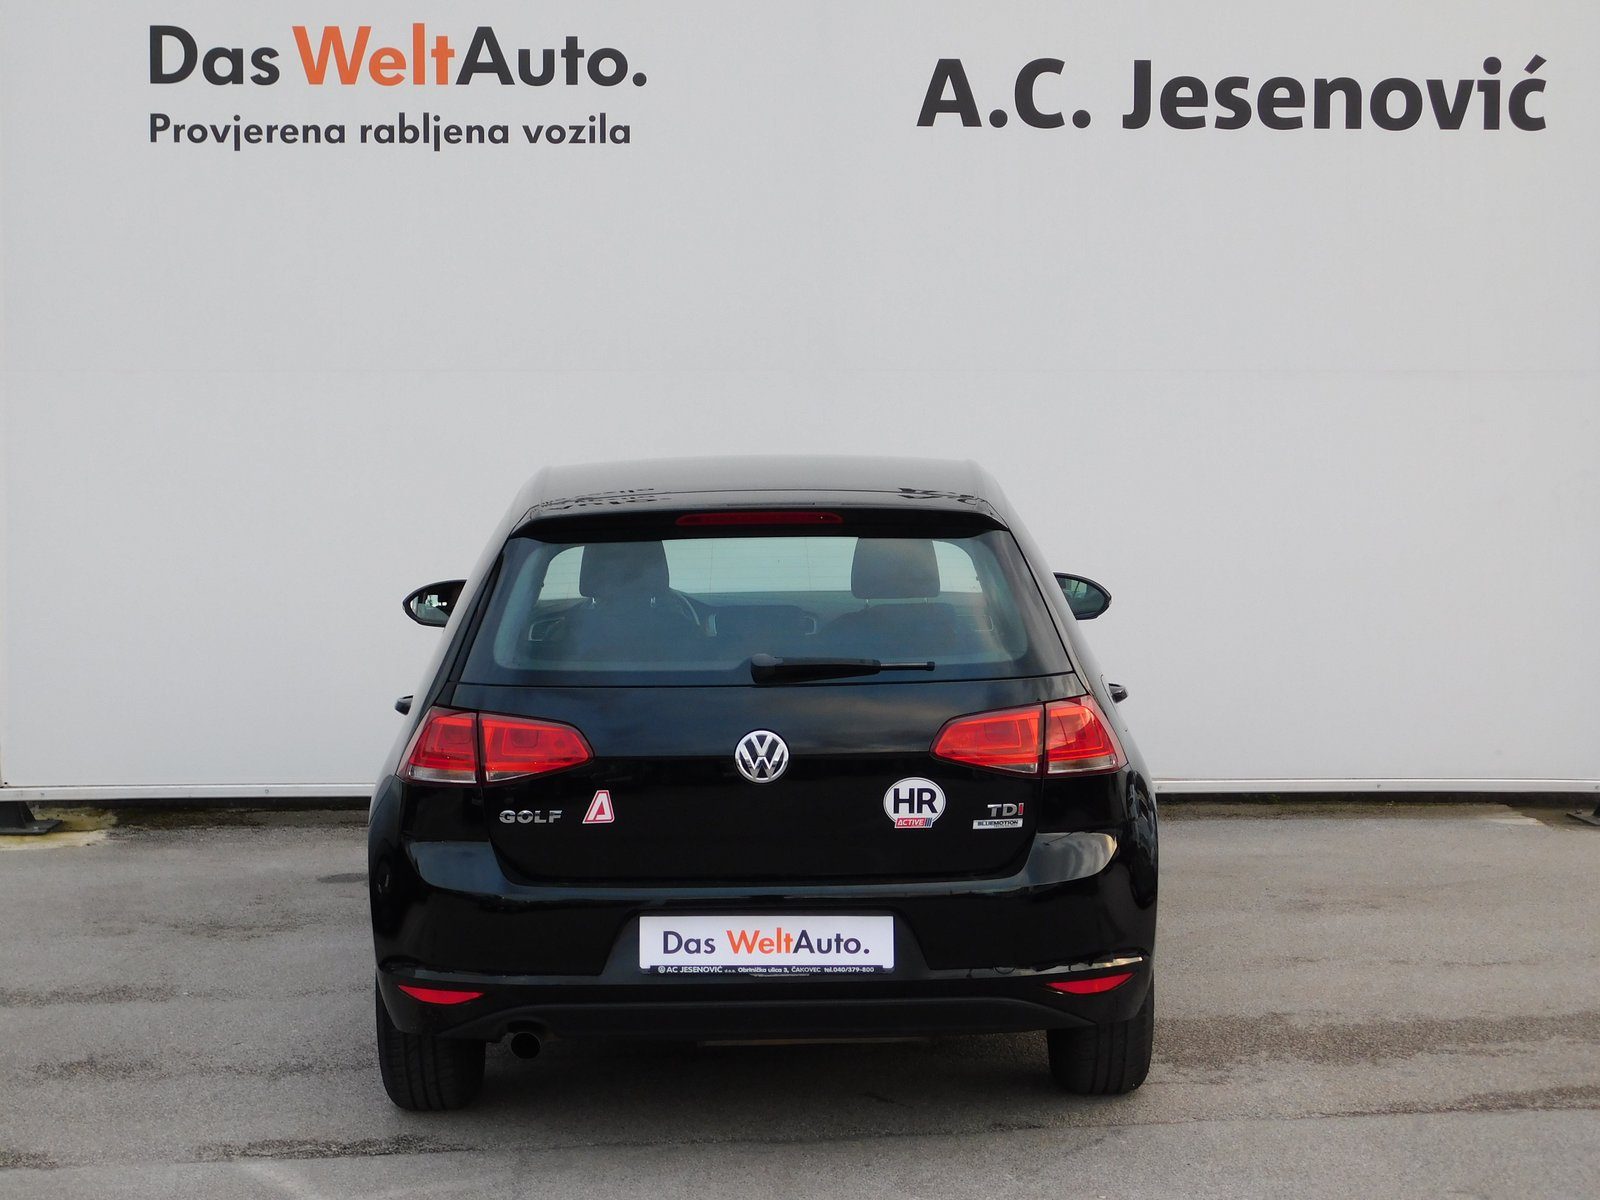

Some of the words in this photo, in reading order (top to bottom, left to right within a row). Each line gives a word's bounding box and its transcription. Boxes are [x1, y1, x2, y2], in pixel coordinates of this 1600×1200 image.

[150, 25, 279, 85] Das
[293, 23, 647, 87] WeltAuto.
[917, 58, 1091, 129] A.C.
[1123, 55, 1547, 131] Jesenović
[150, 113, 345, 151] Provjerena
[361, 112, 508, 151] rabljena
[523, 113, 630, 144] vozila
[893, 787, 938, 814] HR
[987, 802, 1025, 816] TDI
[499, 809, 563, 824] GOLF
[897, 817, 925, 827] ACTIVE
[977, 819, 1019, 827] BLUEMOTION
[663, 931, 716, 955] Das
[727, 927, 870, 955] WeltAuto.
[666, 966, 678, 974] AC
[680, 964, 723, 974] JESENOVIĆ
[791, 965, 822, 974] ČAKOVEC
